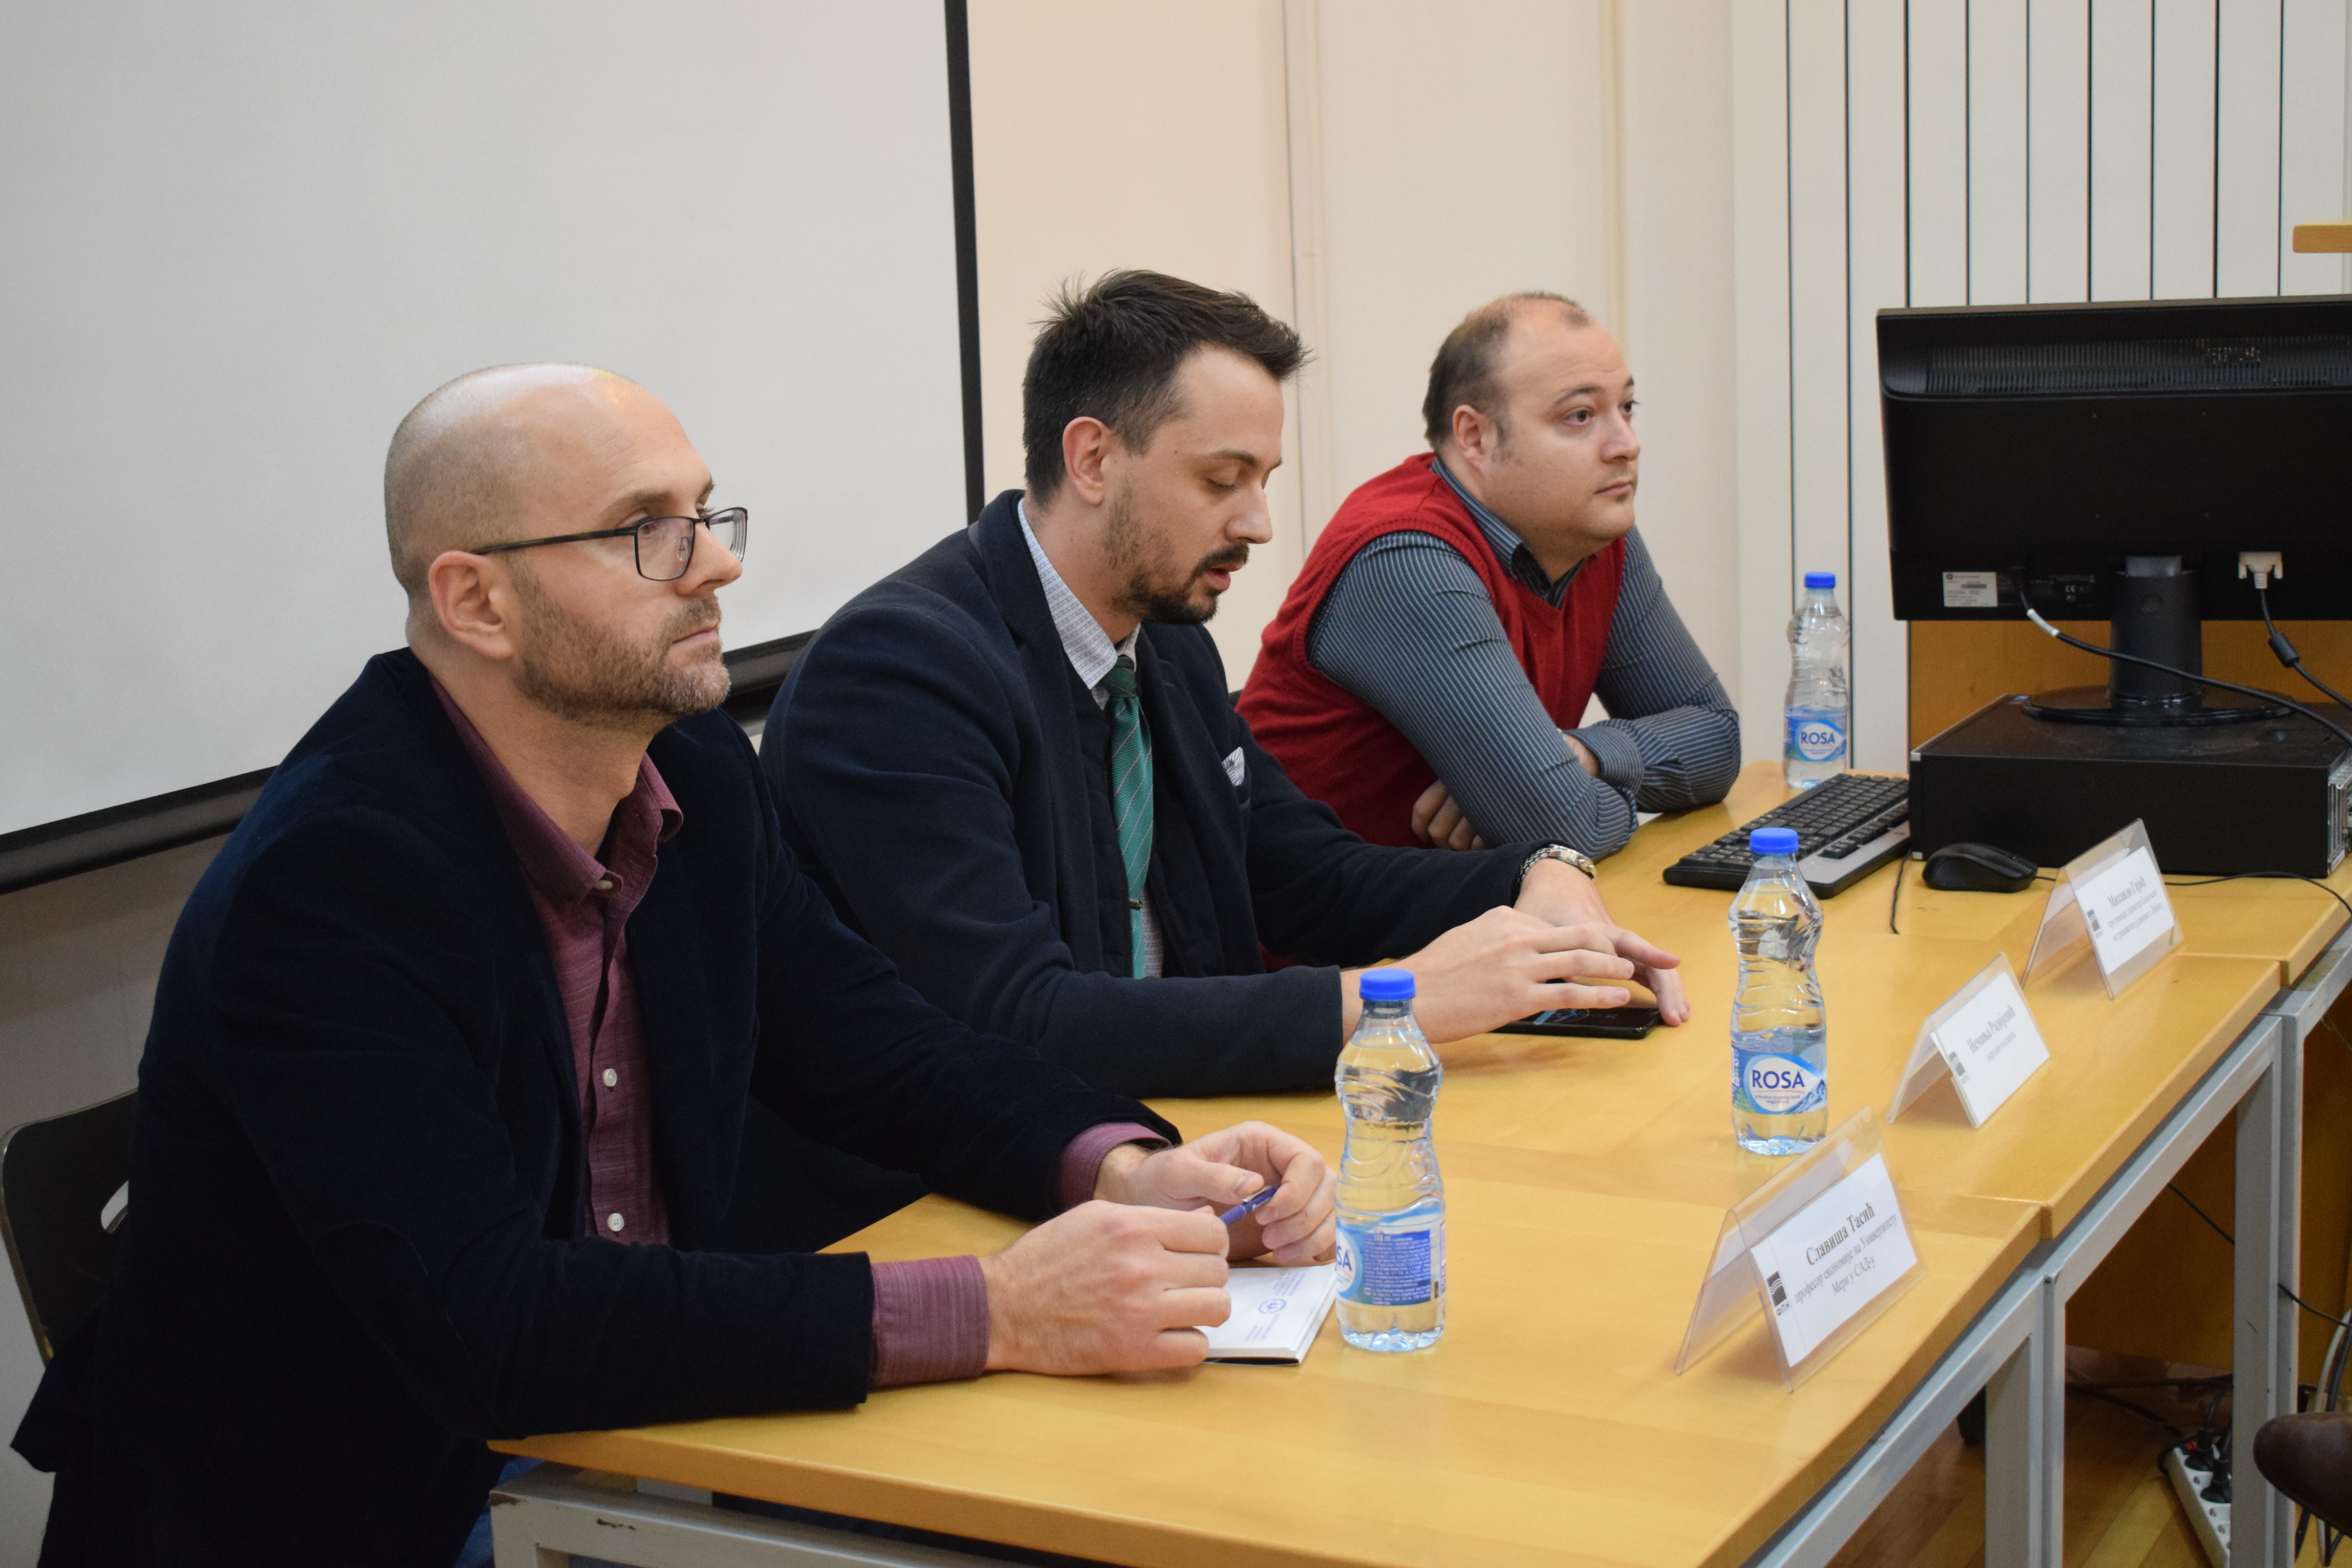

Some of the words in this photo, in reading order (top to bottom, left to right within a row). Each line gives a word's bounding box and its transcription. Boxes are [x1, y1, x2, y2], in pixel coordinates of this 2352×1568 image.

[1800, 731, 1835, 745] ROSA
[1751, 1069, 1805, 1089] ROSA
[1806, 1225, 1849, 1266] Славиша
[1846, 1202, 1875, 1233] Тасић
[1794, 1274, 1824, 1304] професор
[1823, 1249, 1854, 1280] економије
[1853, 1243, 1862, 1256] на
[1859, 1214, 1897, 1249] Универзитету
[1831, 1275, 1850, 1296] Мери
[1848, 1270, 1854, 1285] у
[1854, 1256, 1875, 1277] САД-у
[1776, 1302, 1790, 1316] ФПН
